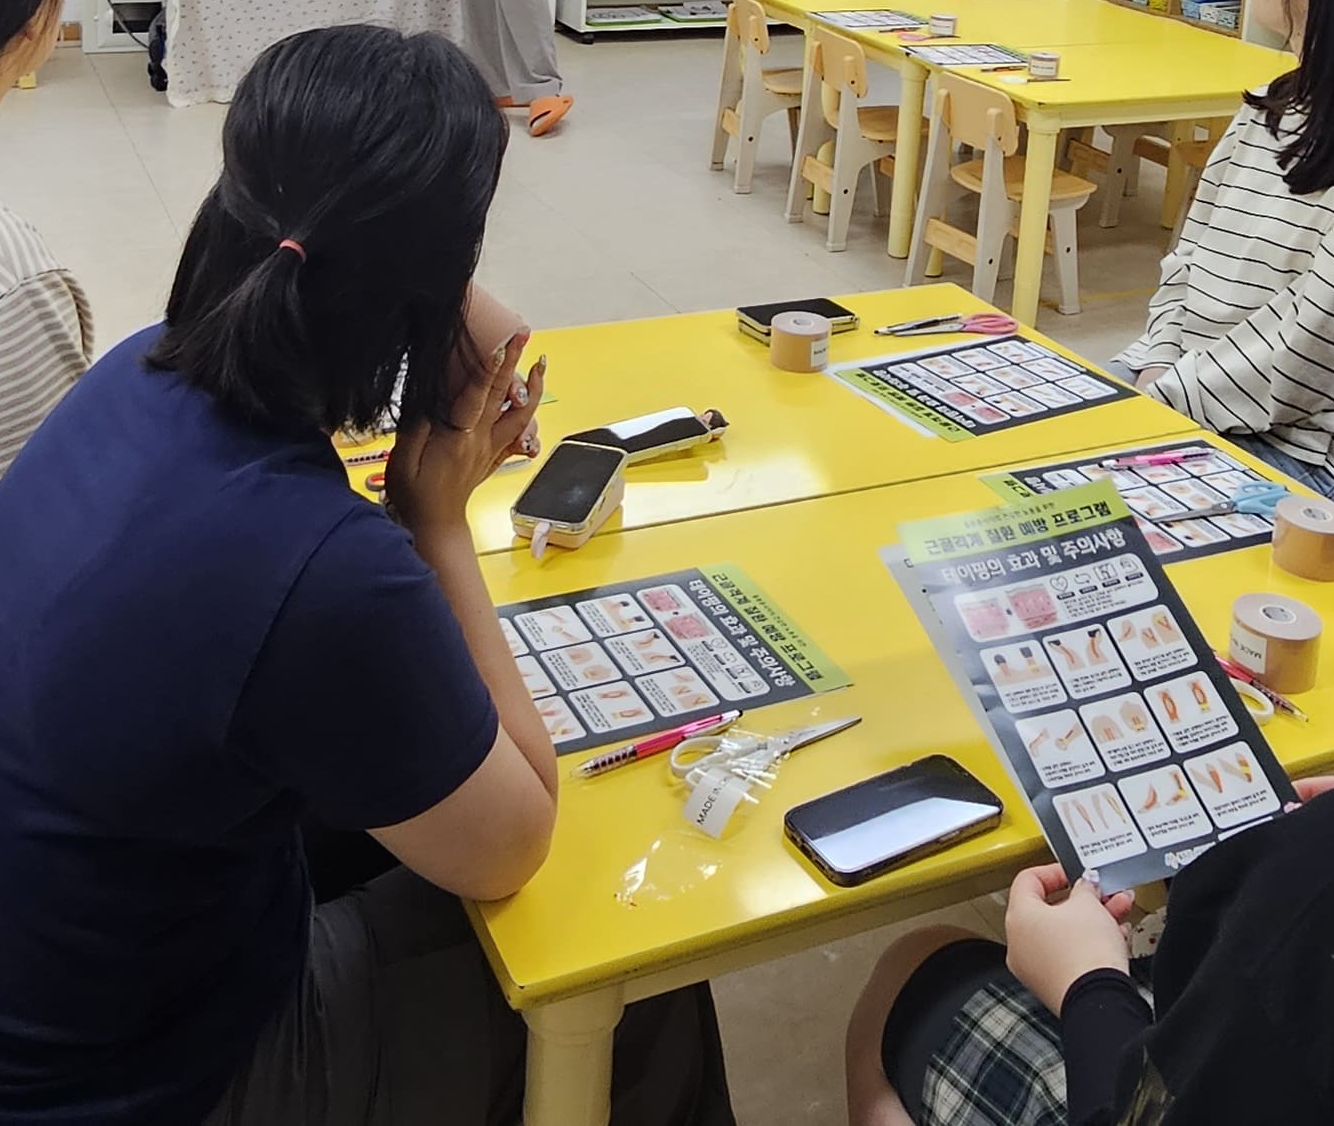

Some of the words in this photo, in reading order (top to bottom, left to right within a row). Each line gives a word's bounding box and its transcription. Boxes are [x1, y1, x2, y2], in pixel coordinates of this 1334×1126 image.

[1018, 517, 1050, 537] 예방
[1051, 500, 1112, 527] 프로그램
[942, 557, 1007, 585] 테이핑의
[1008, 552, 1042, 573] 효과
[1041, 545, 1063, 565] 및
[1059, 528, 1127, 560] 주의사항
[689, 579, 729, 616] 테이핑의
[720, 615, 748, 636] 효과
[750, 646, 796, 687] 주의사항
[780, 643, 825, 681] 프로그램
[696, 795, 716, 826] MADE
